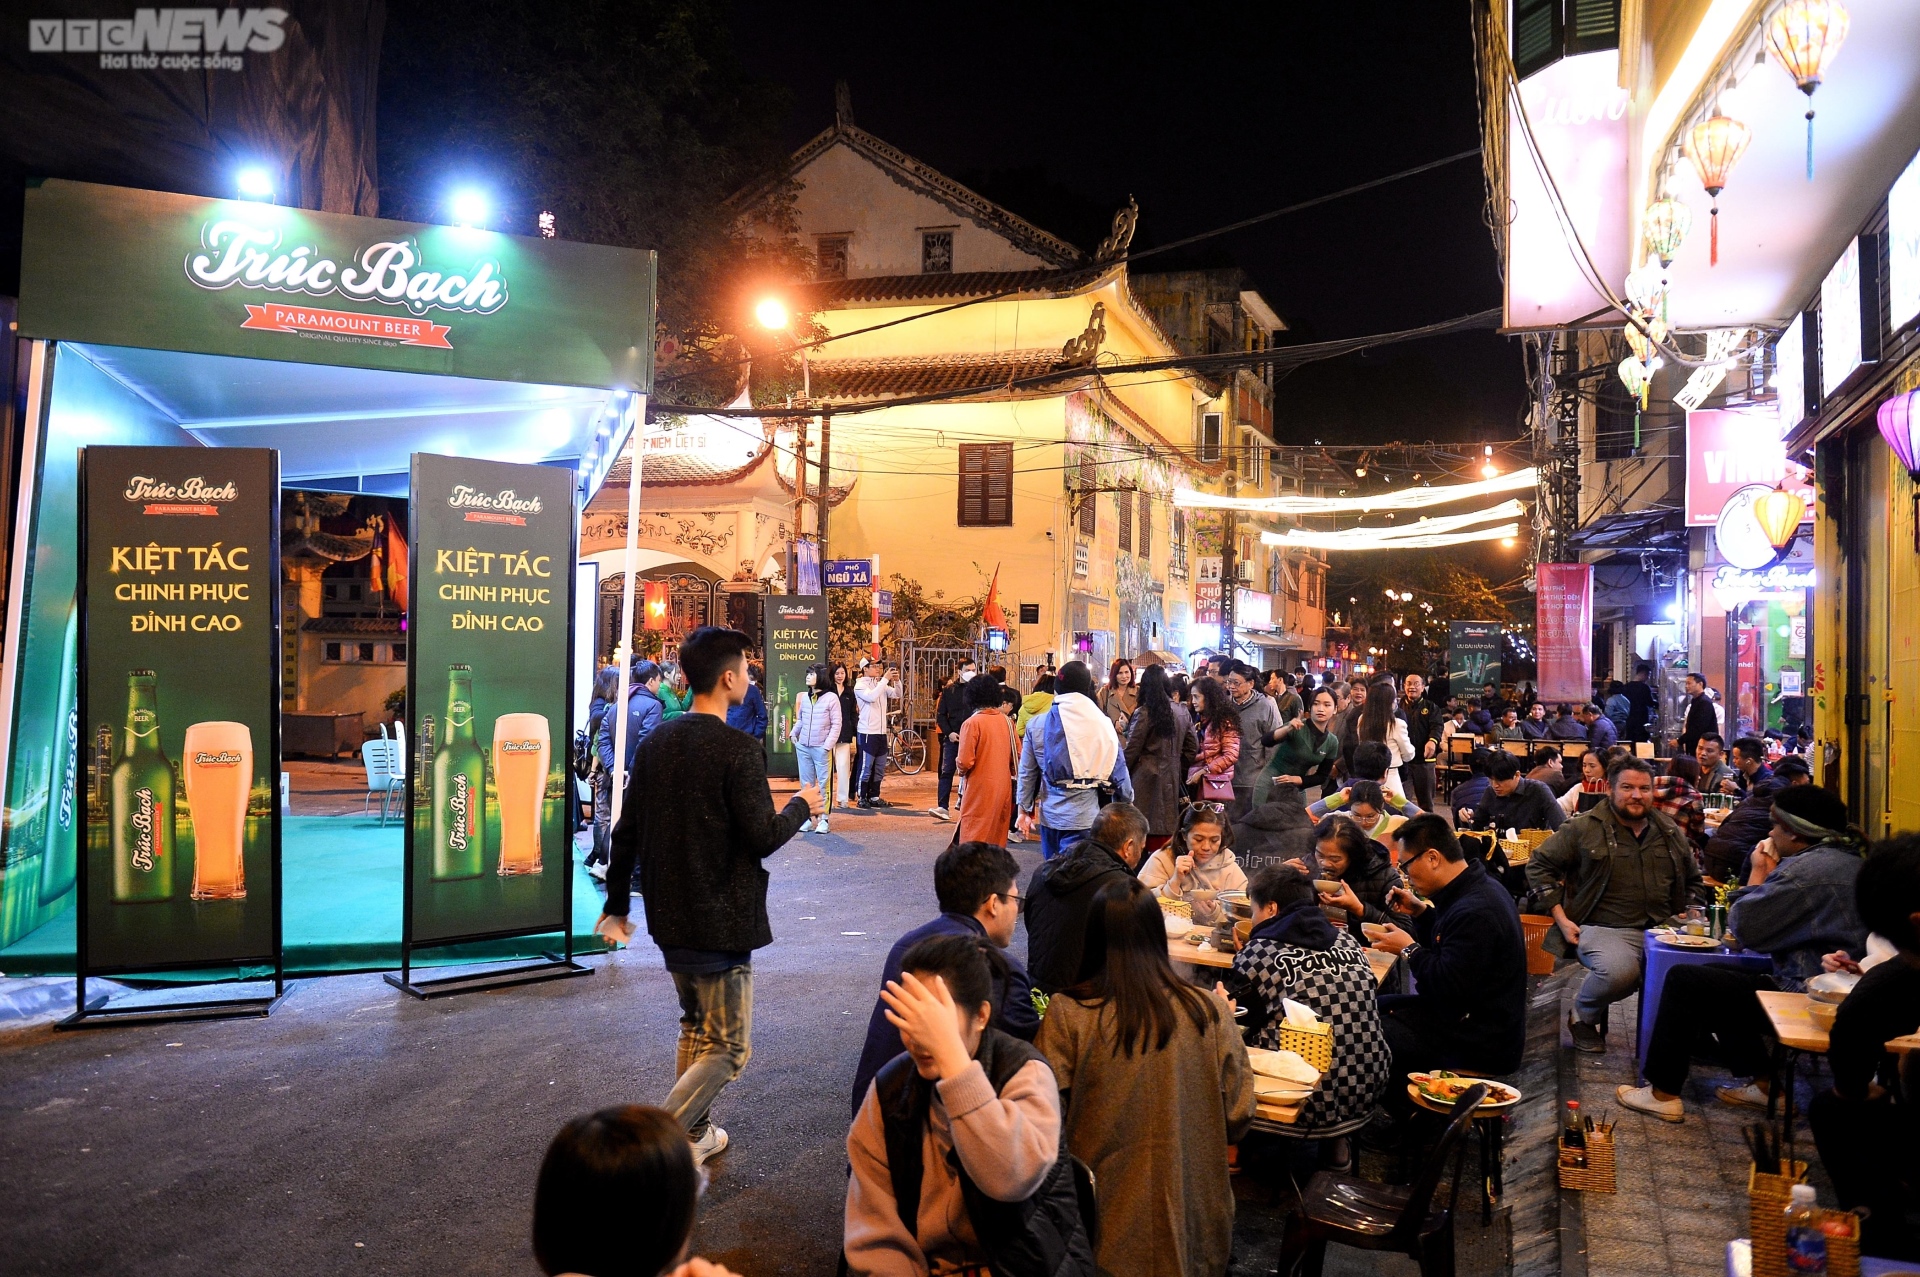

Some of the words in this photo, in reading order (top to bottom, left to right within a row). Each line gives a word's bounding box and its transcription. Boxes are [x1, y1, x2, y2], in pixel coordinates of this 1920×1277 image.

[190, 220, 337, 290] Trúc
[340, 240, 503, 310] Bạch
[275, 310, 380, 333] PARAMOUNT
[383, 320, 421, 336] BEER
[299, 332, 333, 341] ORIGINAL
[333, 335, 362, 344] QUALITY
[363, 338, 382, 346] SINCE
[124, 475, 177, 500] Trúc
[177, 475, 237, 503] Bạch
[449, 484, 492, 508] Trúc
[492, 489, 542, 514] Bạch
[110, 541, 182, 575] KIỆT
[187, 541, 249, 571] TÁC
[436, 546, 496, 577] KIỆT
[499, 550, 551, 577] TÁC
[845, 563, 860, 571] PHỐ
[827, 571, 850, 583] NGŨ
[852, 571, 867, 583] XÃ
[115, 583, 185, 601] CHINH
[189, 583, 249, 604] PHỤC
[438, 584, 497, 602] CHINH
[501, 587, 551, 606] PHỤC
[130, 610, 186, 632] ĐỈNH
[190, 614, 242, 632] CAO
[451, 609, 498, 631] ĐỈNH
[501, 615, 544, 632] CAO
[1204, 612, 1217, 622] 16
[773, 628, 796, 641] KIỆT
[797, 628, 819, 640] TÁC
[779, 652, 798, 661] ĐỈNH
[798, 653, 816, 661] CAO
[798, 643, 819, 651] PHỤC
[449, 773, 469, 814] Bạch
[131, 787, 156, 833] Bạch
[449, 813, 467, 851] Trúc
[131, 832, 154, 872] Trúc
